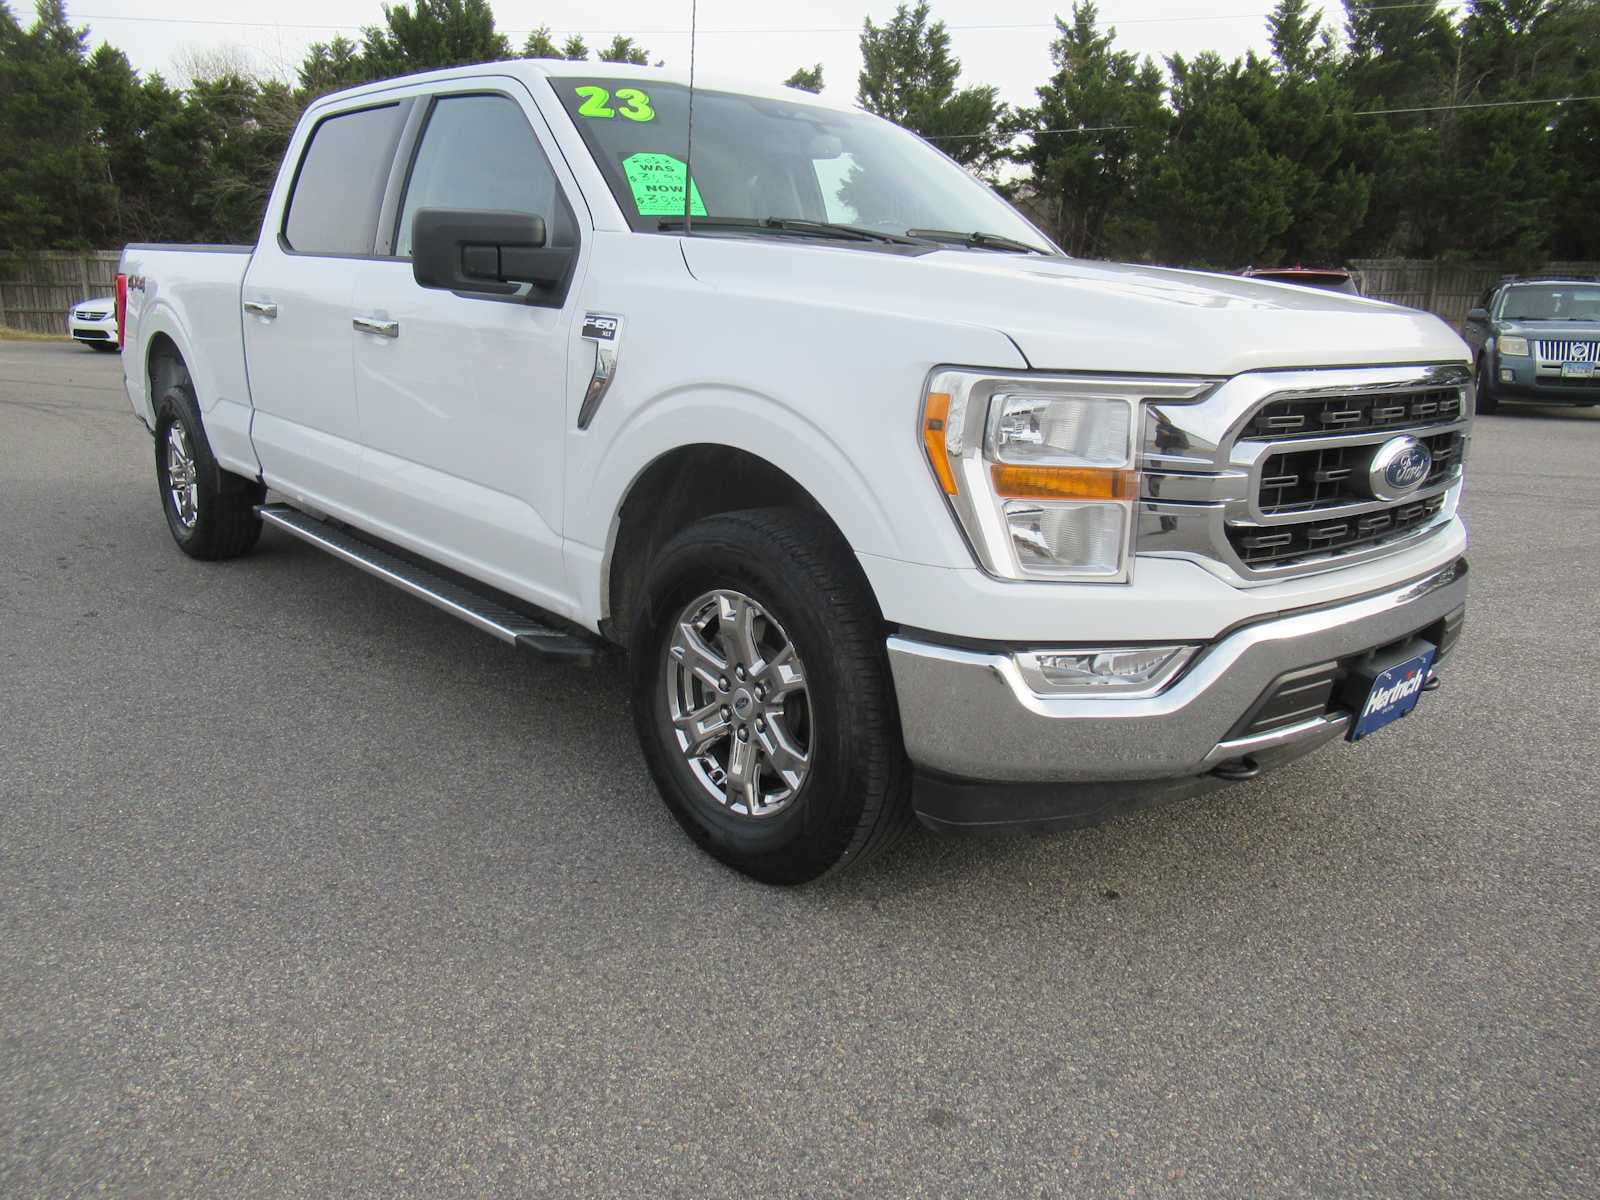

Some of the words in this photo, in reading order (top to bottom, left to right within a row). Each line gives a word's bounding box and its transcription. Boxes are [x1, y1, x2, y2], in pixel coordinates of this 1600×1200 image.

[575, 86, 655, 122] 23
[639, 164, 675, 172] WAS
[646, 185, 683, 193] NOW
[1395, 455, 1425, 482] Ford
